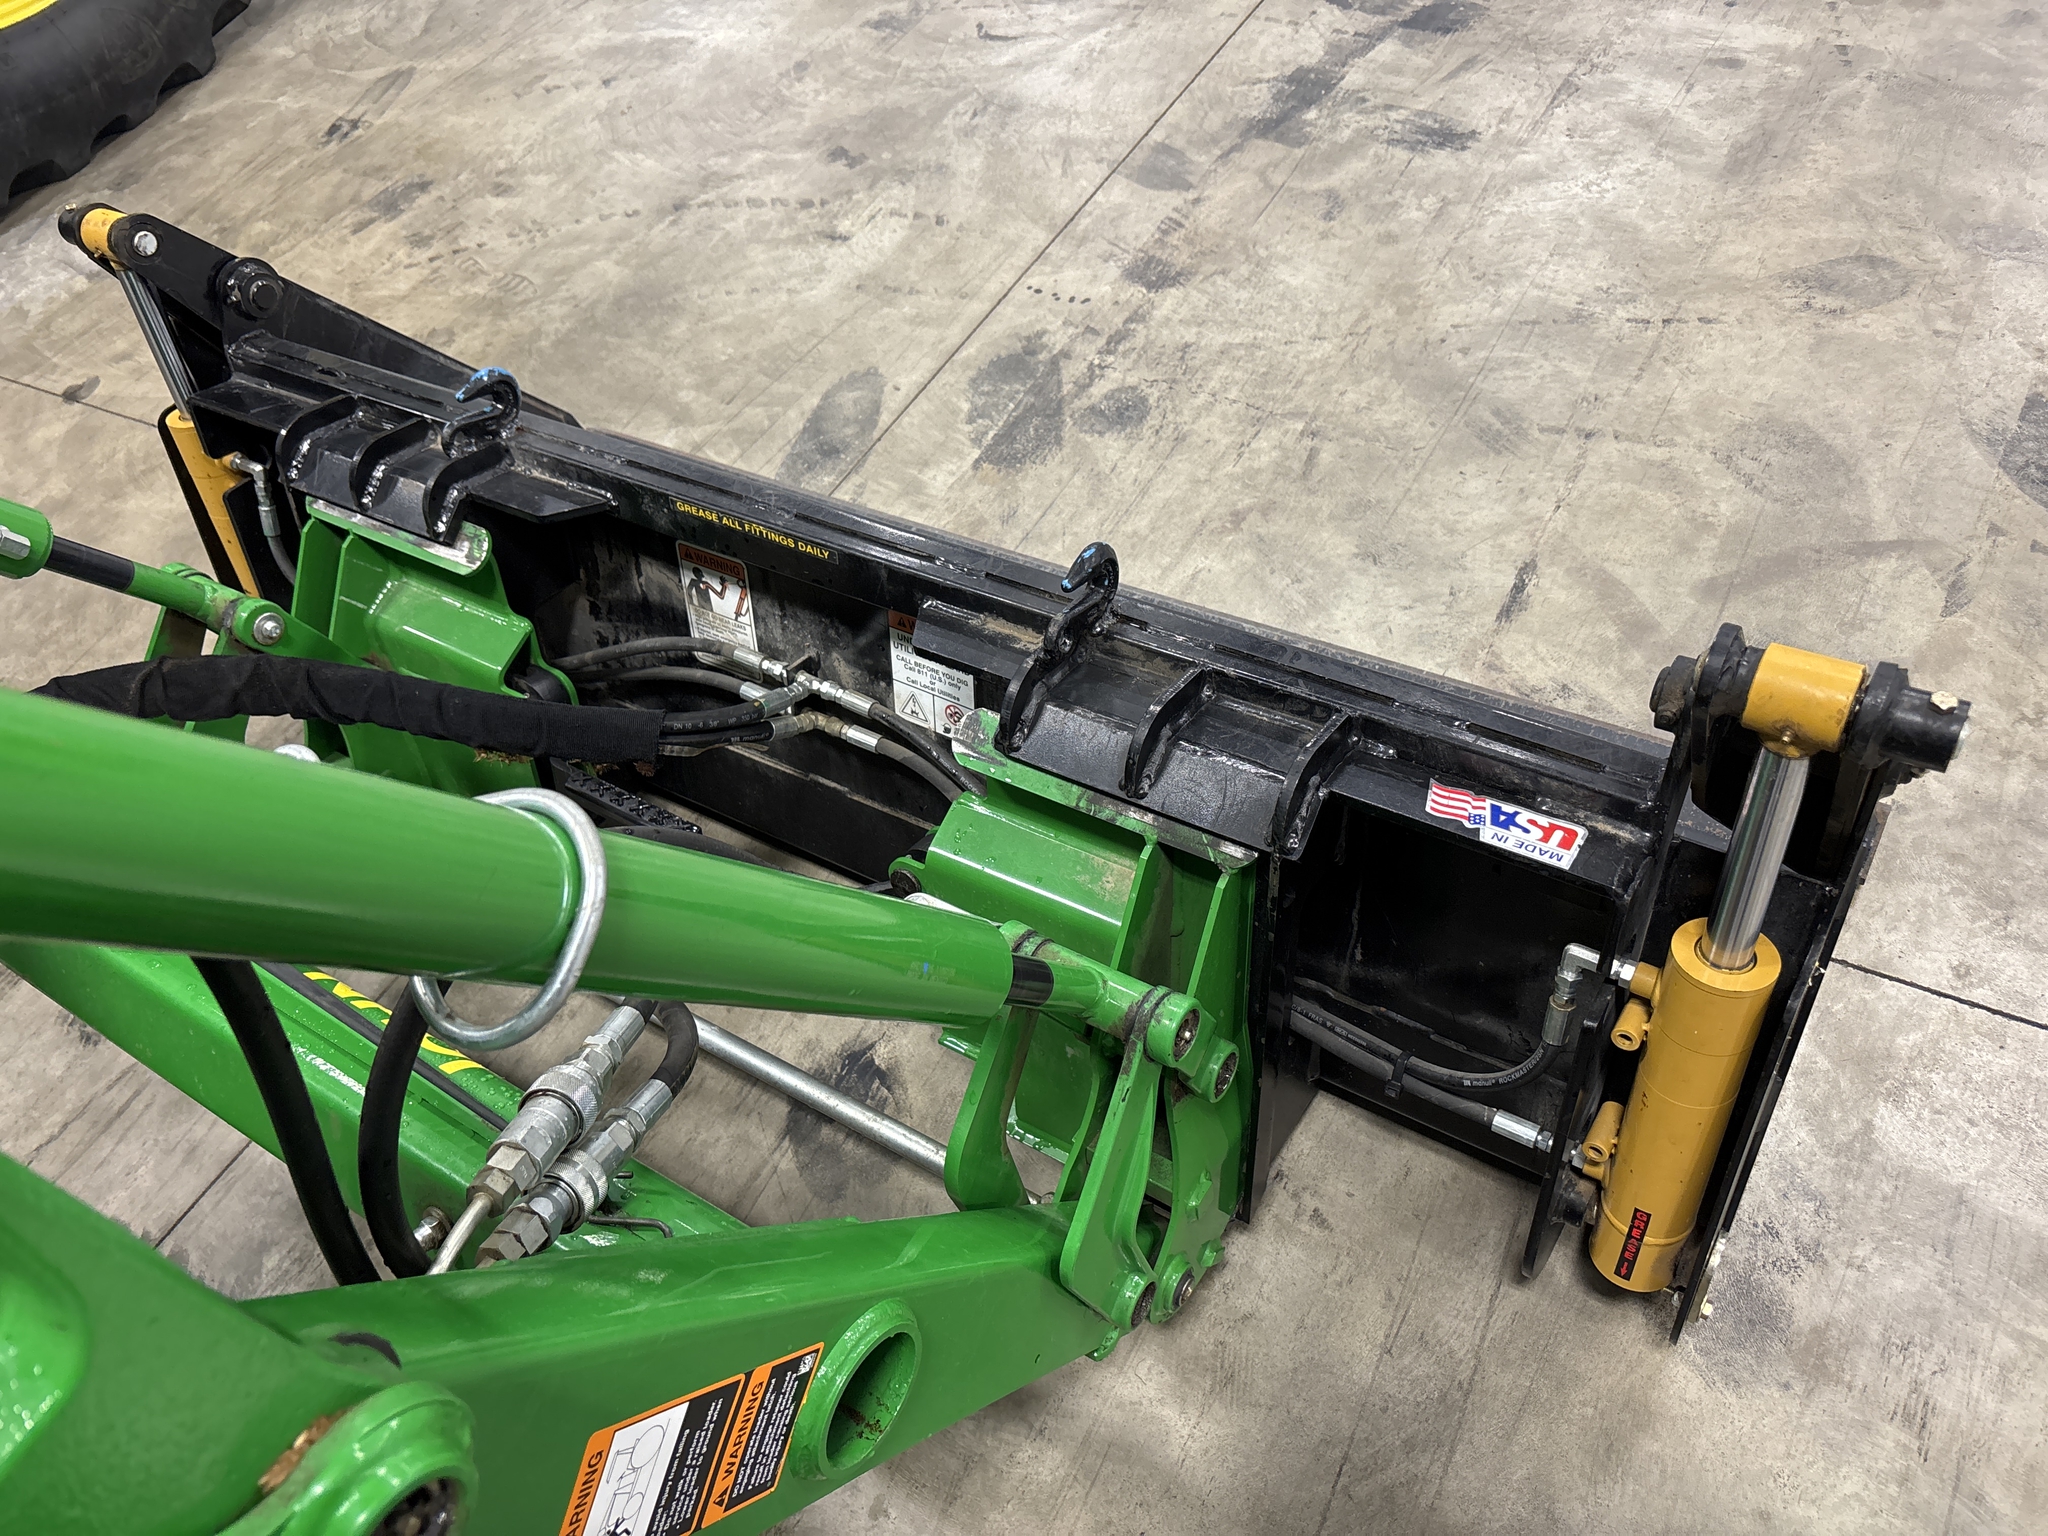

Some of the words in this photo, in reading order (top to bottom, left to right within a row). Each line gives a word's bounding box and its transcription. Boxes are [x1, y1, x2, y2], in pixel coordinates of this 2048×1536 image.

[676, 502, 719, 523] GREASE
[722, 516, 742, 531] ALL
[745, 523, 795, 548] FITTINGS
[798, 541, 830, 559] DAILY
[693, 551, 740, 576] WARNING
[893, 641, 914, 655] UTILI
[895, 654, 913, 666] CALL
[914, 660, 940, 676] BEFORE
[941, 669, 956, 682] YOU
[956, 675, 969, 687] DIG
[903, 663, 917, 673] Call
[917, 668, 928, 677] 811
[929, 673, 947, 685] (U.S.)
[948, 681, 962, 691] only
[906, 676, 919, 686] Call
[919, 681, 936, 692] Local
[1490, 803, 1579, 851] USA
[1491, 832, 1510, 844] IN
[1512, 840, 1564, 862] MADE
[1308, 1012, 1324, 1024] FRAS
[1624, 1211, 1648, 1261] GREASE
[721, 1381, 764, 1481] WARNING
[732, 1484, 740, 1498] DO
[737, 1466, 746, 1484] NOT
[744, 1434, 756, 1464] operate
[753, 1409, 765, 1434] loader
[763, 1378, 777, 1408] without
[755, 1465, 764, 1486] result
[761, 1456, 767, 1464] in
[765, 1412, 782, 1455] attachment
[780, 1373, 797, 1410] detaching
[757, 1454, 763, 1463] to
[761, 1424, 773, 1453] engage
[771, 1394, 784, 1423] retainer
[782, 1371, 792, 1392] could
[760, 1465, 769, 1484] from
[766, 1441, 777, 1465] loader
[775, 1409, 789, 1439] causing
[786, 1380, 799, 1408] serious
[652, 1507, 663, 1531] avoid
[660, 1481, 672, 1506] injury
[668, 1458, 679, 1479] from
[676, 1428, 690, 1457] falling
[663, 1517, 672, 1530] Do
[670, 1500, 678, 1516] not
[675, 1478, 685, 1499] walk
[682, 1467, 688, 1476] or
[686, 1430, 700, 1465] perform
[672, 1494, 685, 1525] service
[683, 1468, 693, 1493] under
[694, 1430, 706, 1458] raised
[677, 1496, 690, 1523] Lower
[687, 1467, 699, 1495] loader
[697, 1455, 704, 1465] to
[701, 1423, 715, 1453] ground
[712, 1398, 724, 1421] when
[739, 1458, 754, 1494] engaging
[751, 1413, 769, 1457] attachment
[766, 1458, 777, 1481] bodily
[782, 1426, 787, 1434] or
[686, 1485, 699, 1519] parked.
